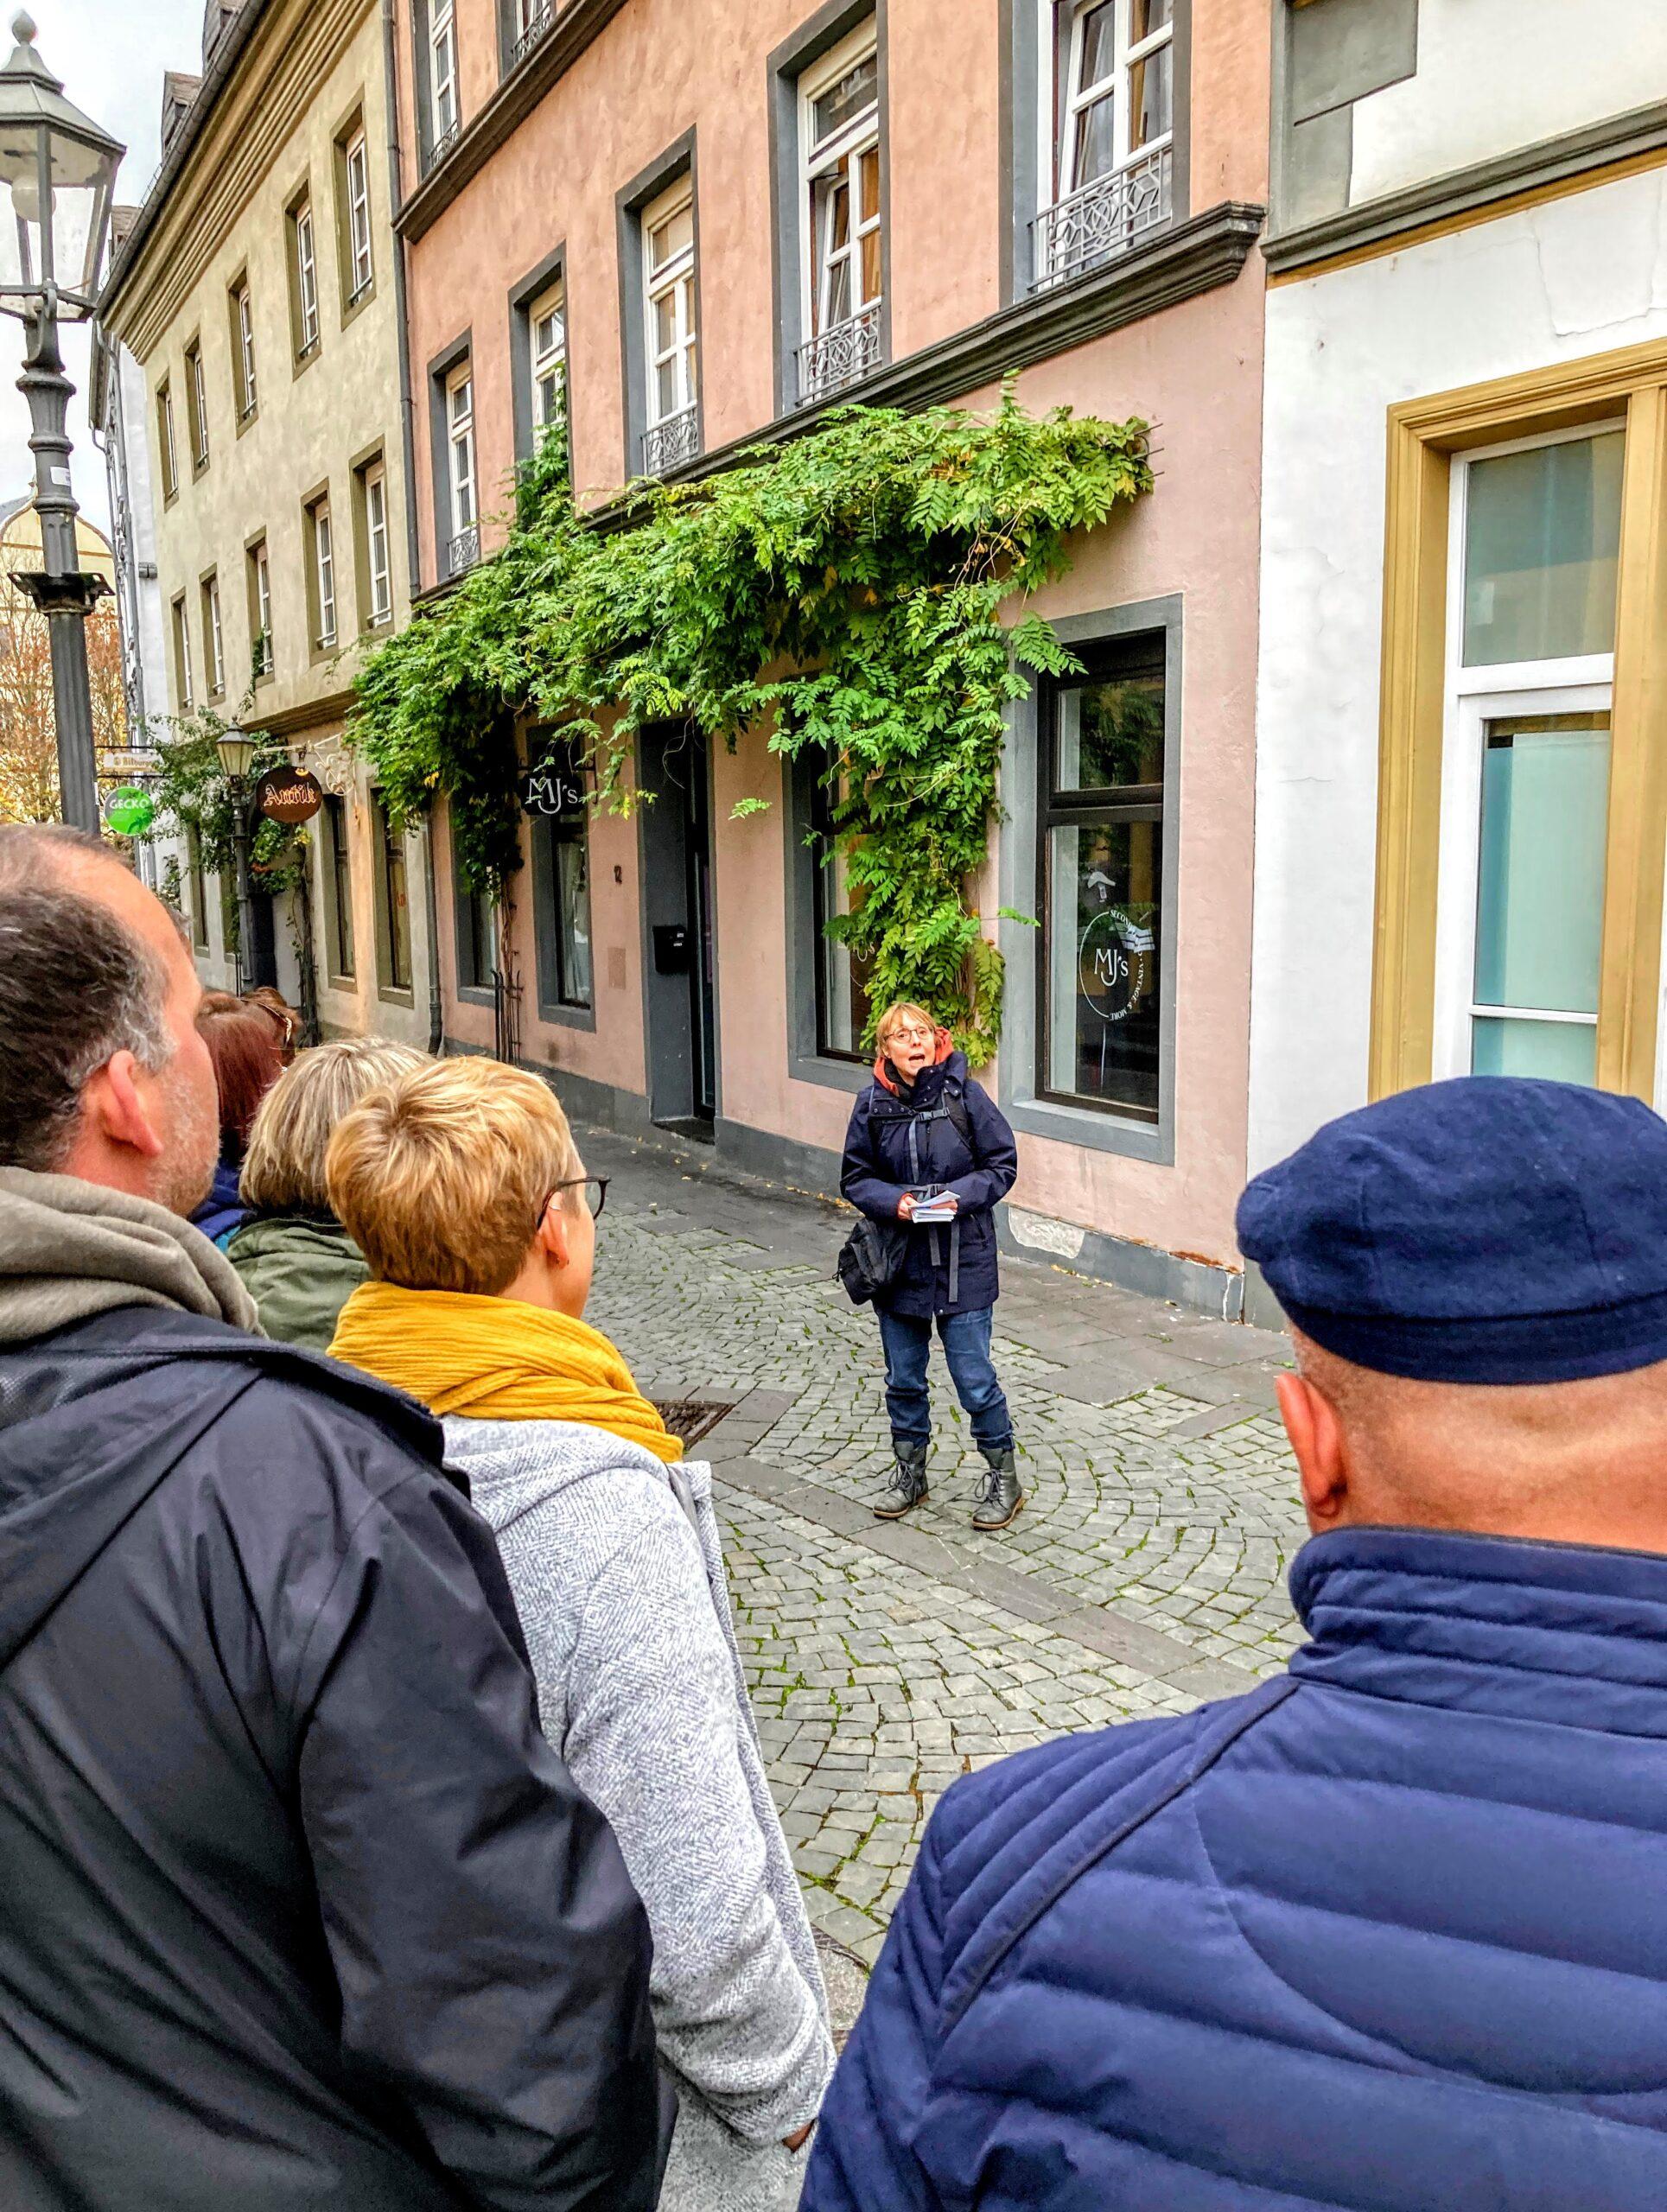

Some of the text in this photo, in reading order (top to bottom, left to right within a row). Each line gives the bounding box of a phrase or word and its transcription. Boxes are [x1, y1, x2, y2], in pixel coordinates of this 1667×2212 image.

[109, 798, 150, 810] GECKO
[264, 782, 316, 806] Antik
[528, 778, 578, 814] MJ's
[1094, 948, 1129, 986] MJ's
[1133, 963, 1144, 1002] VINTAGE
[1109, 1007, 1128, 1020] MORE
